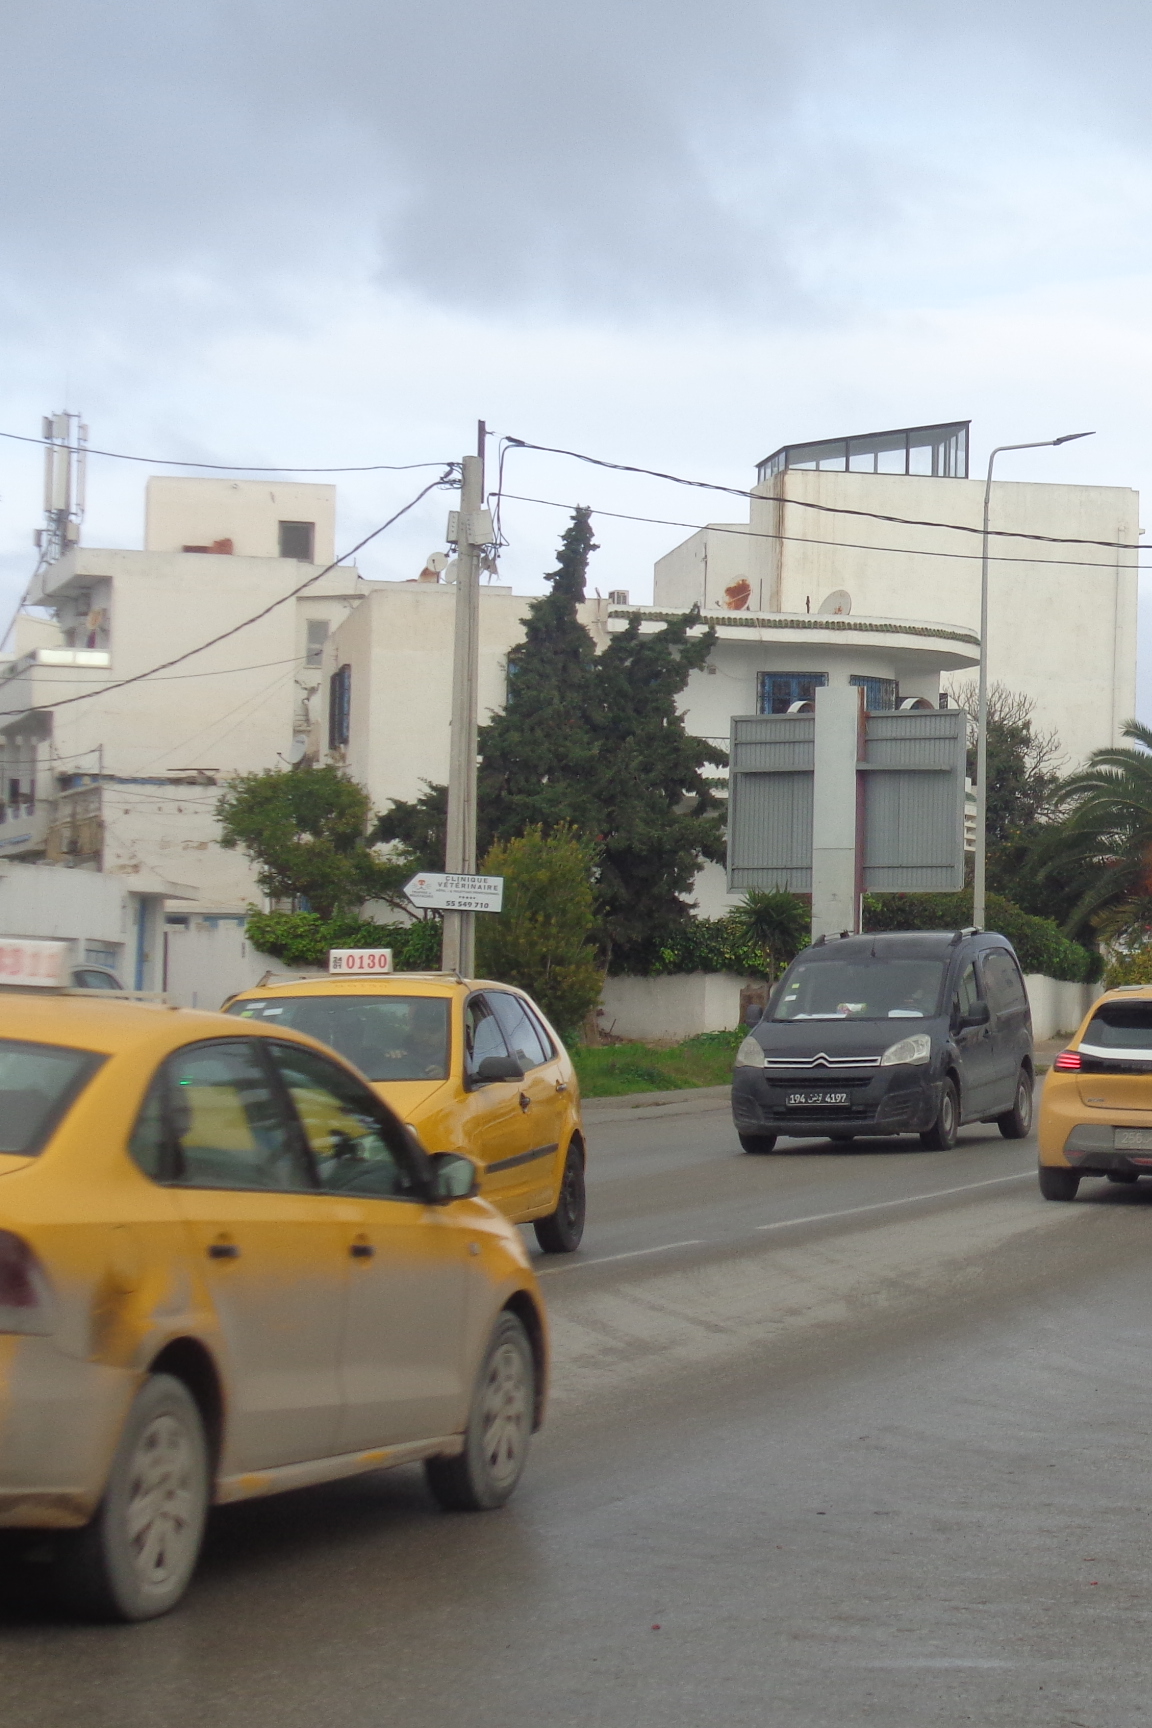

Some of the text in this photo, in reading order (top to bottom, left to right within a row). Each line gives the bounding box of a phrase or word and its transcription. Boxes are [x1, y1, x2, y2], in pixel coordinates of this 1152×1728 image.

[445, 875, 489, 883] CLINIQUE
[437, 881, 499, 891] VÉTÉRINAIRE
[346, 954, 388, 969] 0130
[789, 1094, 806, 1104] 194
[825, 1093, 847, 1103] 4197
[1121, 1132, 1143, 1144] 256
